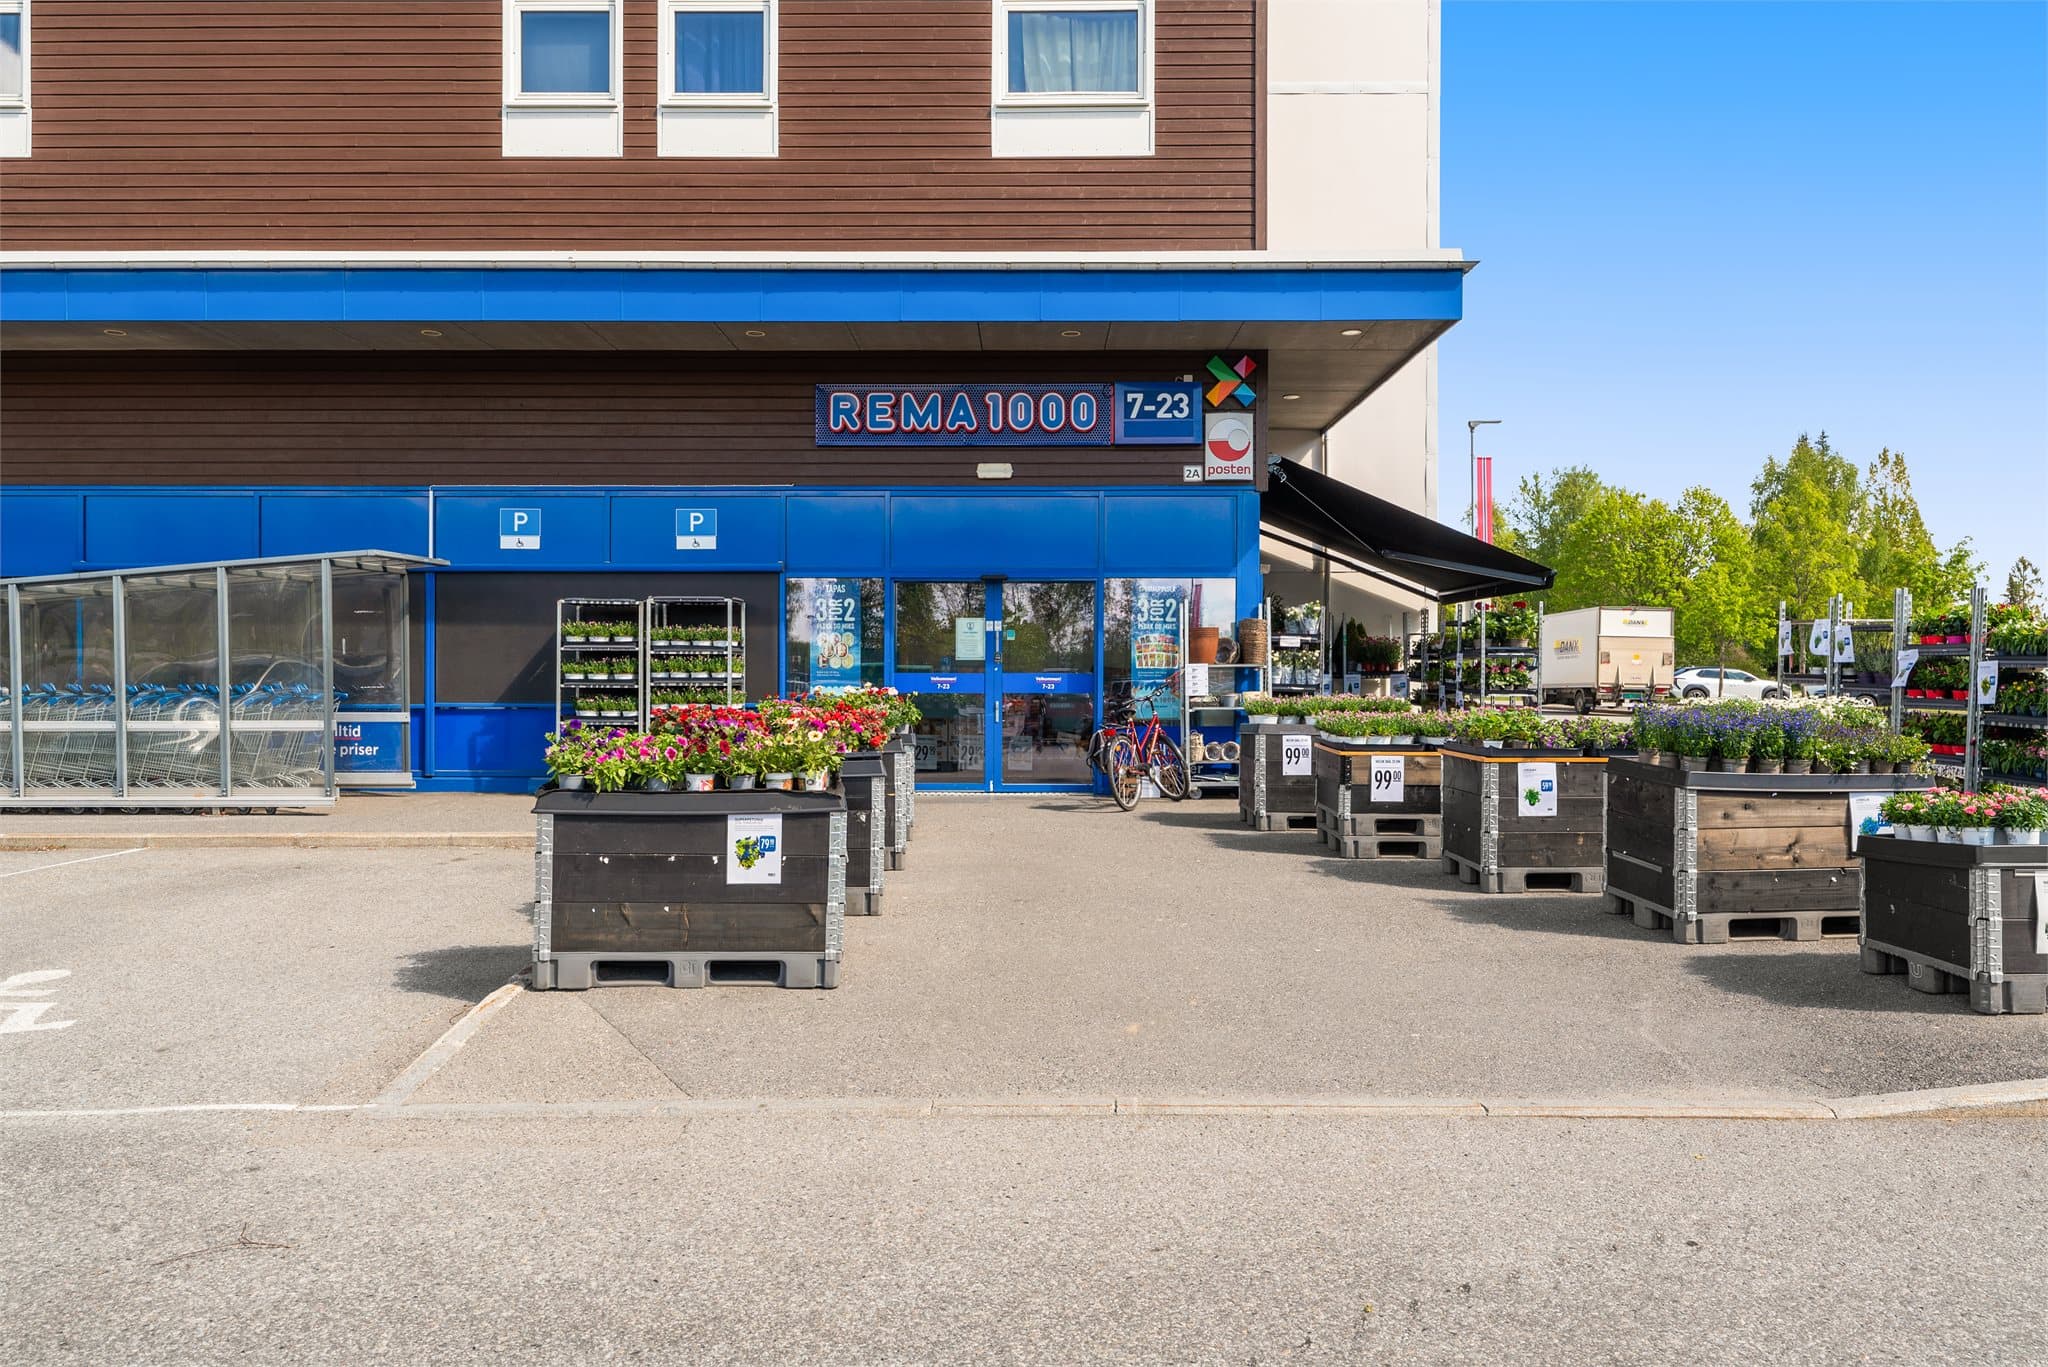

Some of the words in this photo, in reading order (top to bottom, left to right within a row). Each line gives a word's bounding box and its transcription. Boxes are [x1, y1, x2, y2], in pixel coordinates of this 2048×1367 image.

[830, 392, 978, 432] REMA
[985, 392, 1097, 432] 1000
[1127, 392, 1190, 419] 7-23
[1185, 469, 1200, 478] 2A
[1207, 464, 1251, 476] posten
[513, 512, 529, 532] P
[689, 512, 704, 532] P
[825, 584, 846, 593] TAPAS
[816, 598, 827, 622] 3
[828, 599, 843, 621] FOR
[844, 598, 855, 622] 2
[1137, 598, 1148, 622] 3
[1150, 599, 1164, 621] FOR
[1165, 598, 1177, 622] 2
[340, 743, 379, 757] priser
[1285, 747, 1300, 765] 99
[1374, 770, 1392, 790] 99
[760, 838, 769, 849] 79
